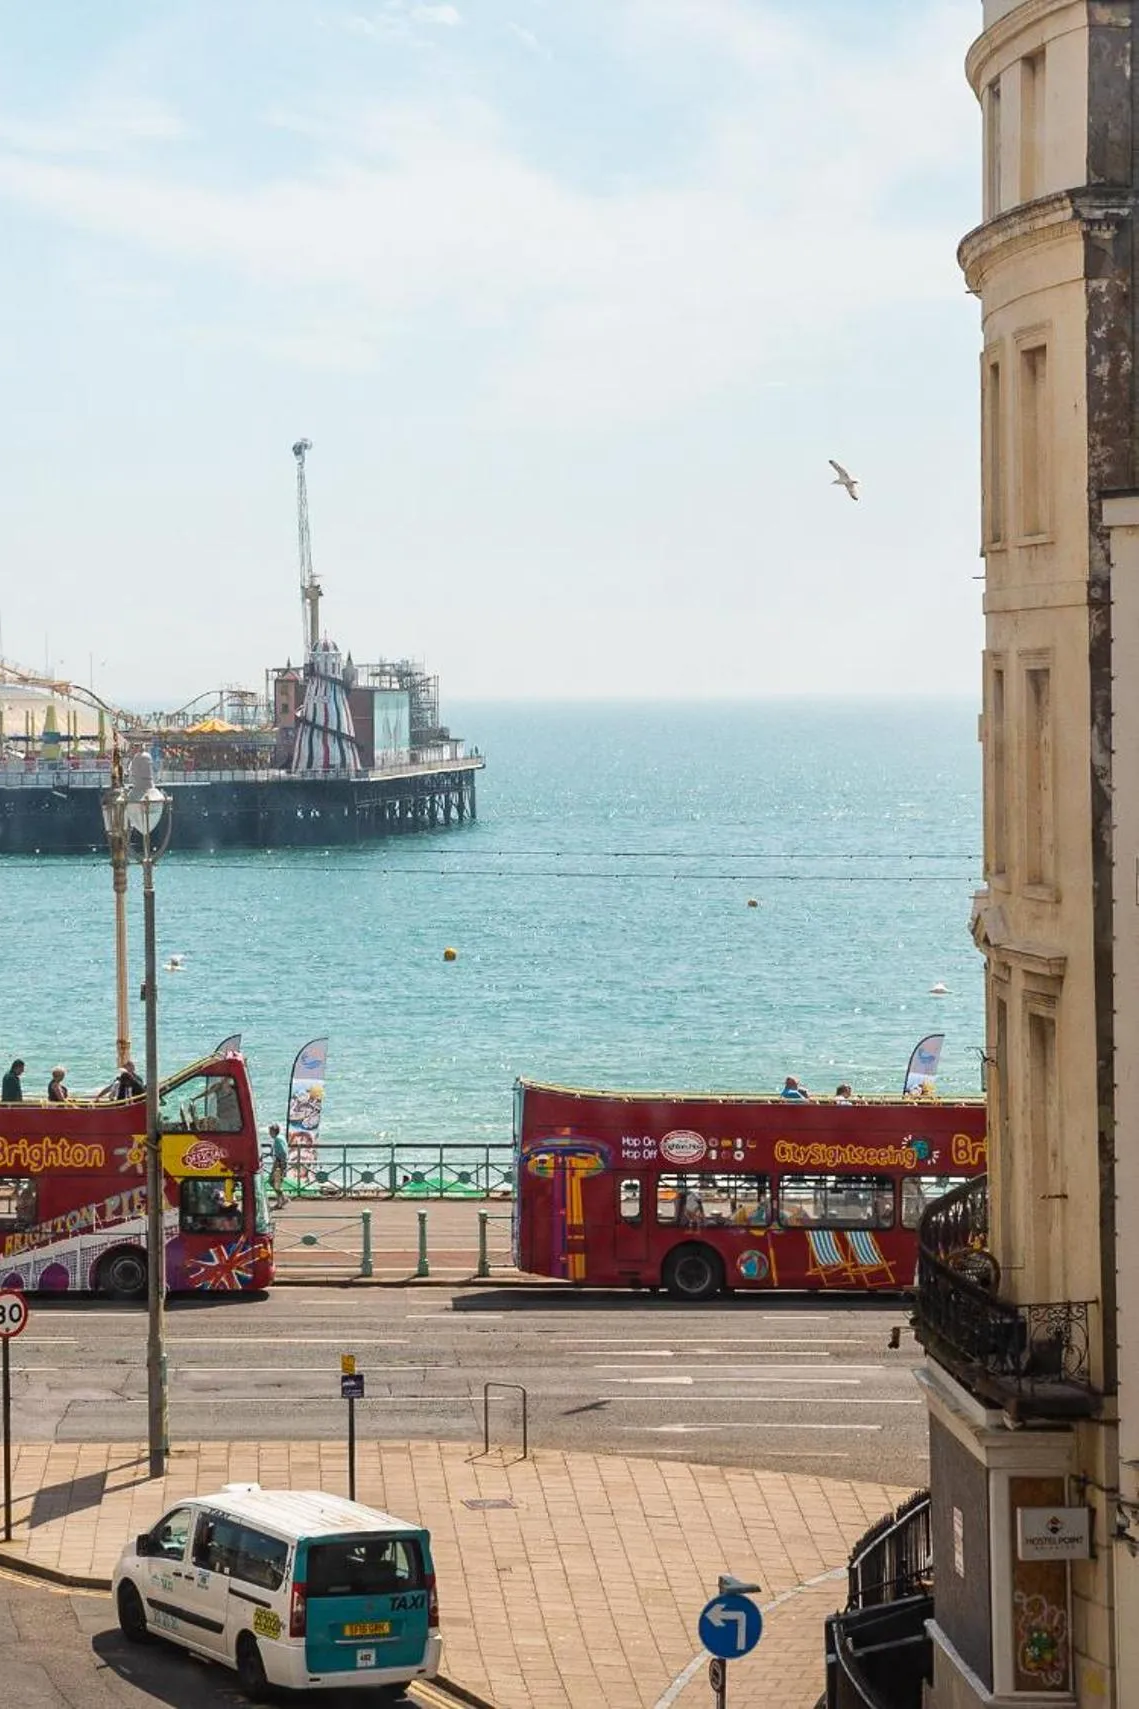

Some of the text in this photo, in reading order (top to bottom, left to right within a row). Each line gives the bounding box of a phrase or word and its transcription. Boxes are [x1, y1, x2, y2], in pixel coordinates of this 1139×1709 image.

[622, 1136, 656, 1147] Hop On
[622, 1149, 658, 1159] Hop Off
[774, 1140, 917, 1169] CitySightseeing
[391, 1595, 427, 1612] TAXI
